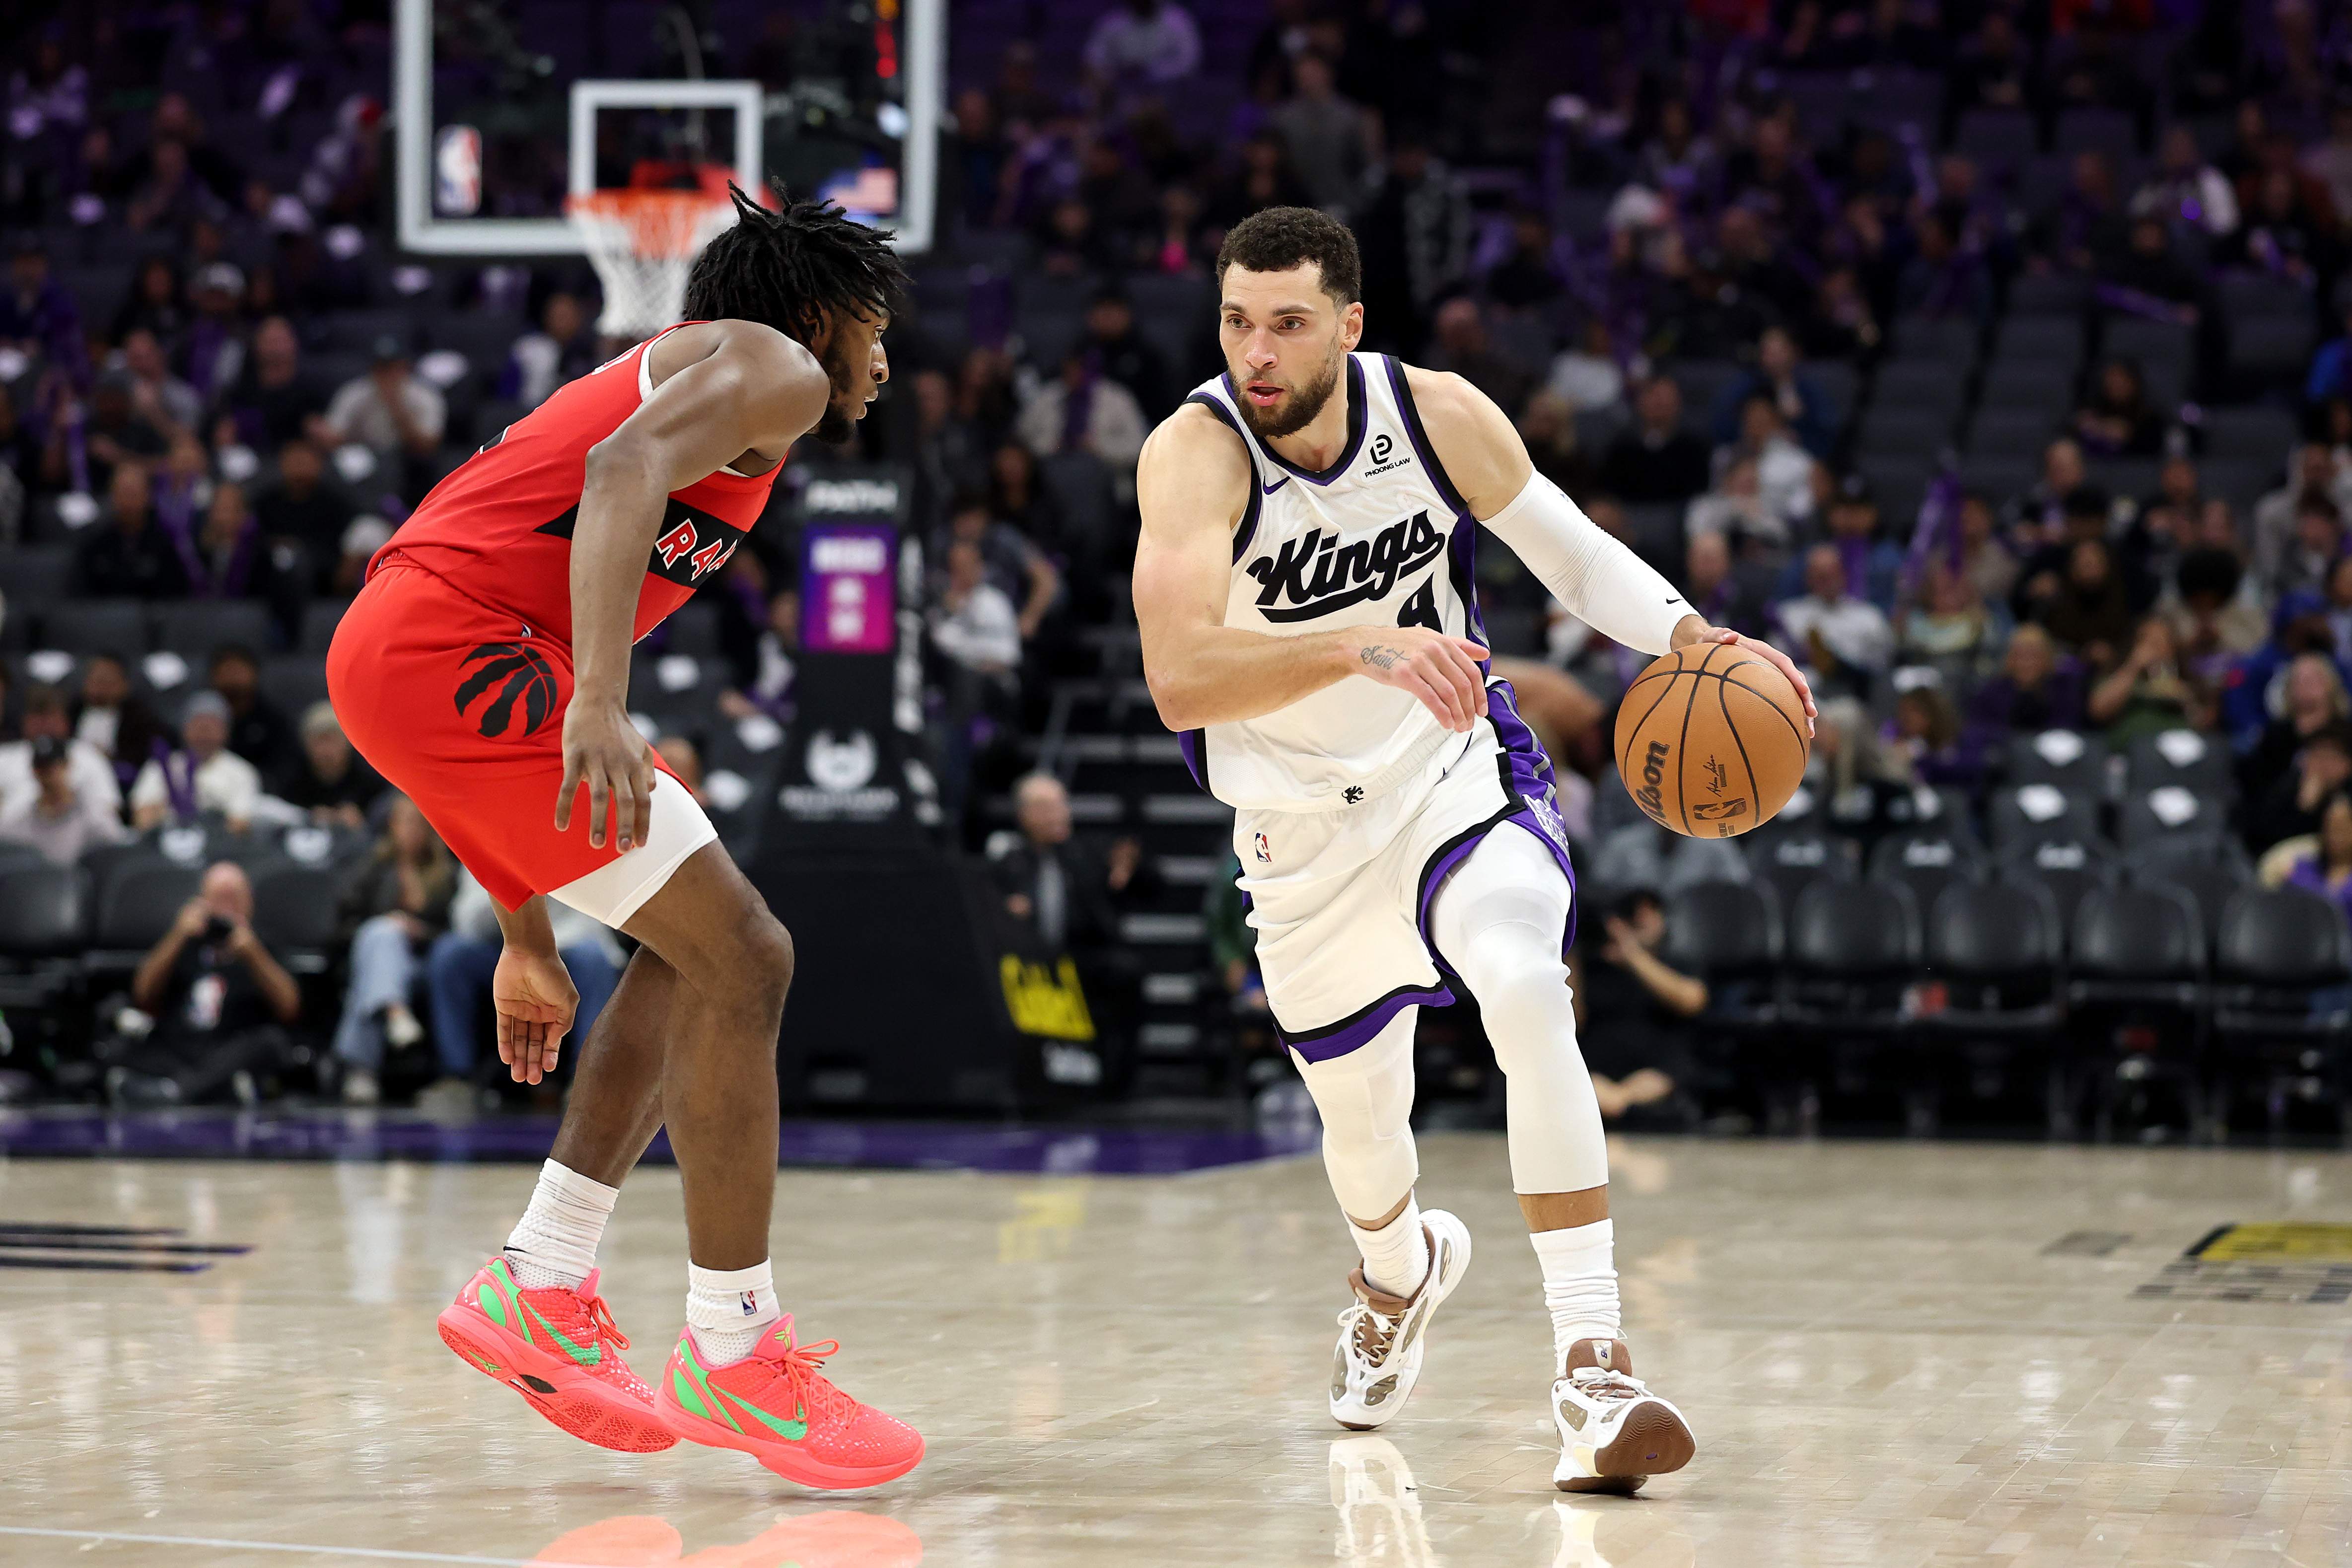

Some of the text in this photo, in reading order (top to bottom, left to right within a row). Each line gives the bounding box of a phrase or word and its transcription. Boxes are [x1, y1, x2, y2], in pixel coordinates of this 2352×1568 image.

[1364, 457, 1410, 478] PHOONG LAW
[1246, 509, 1446, 623] Kings
[1636, 740, 1672, 828] ilson
